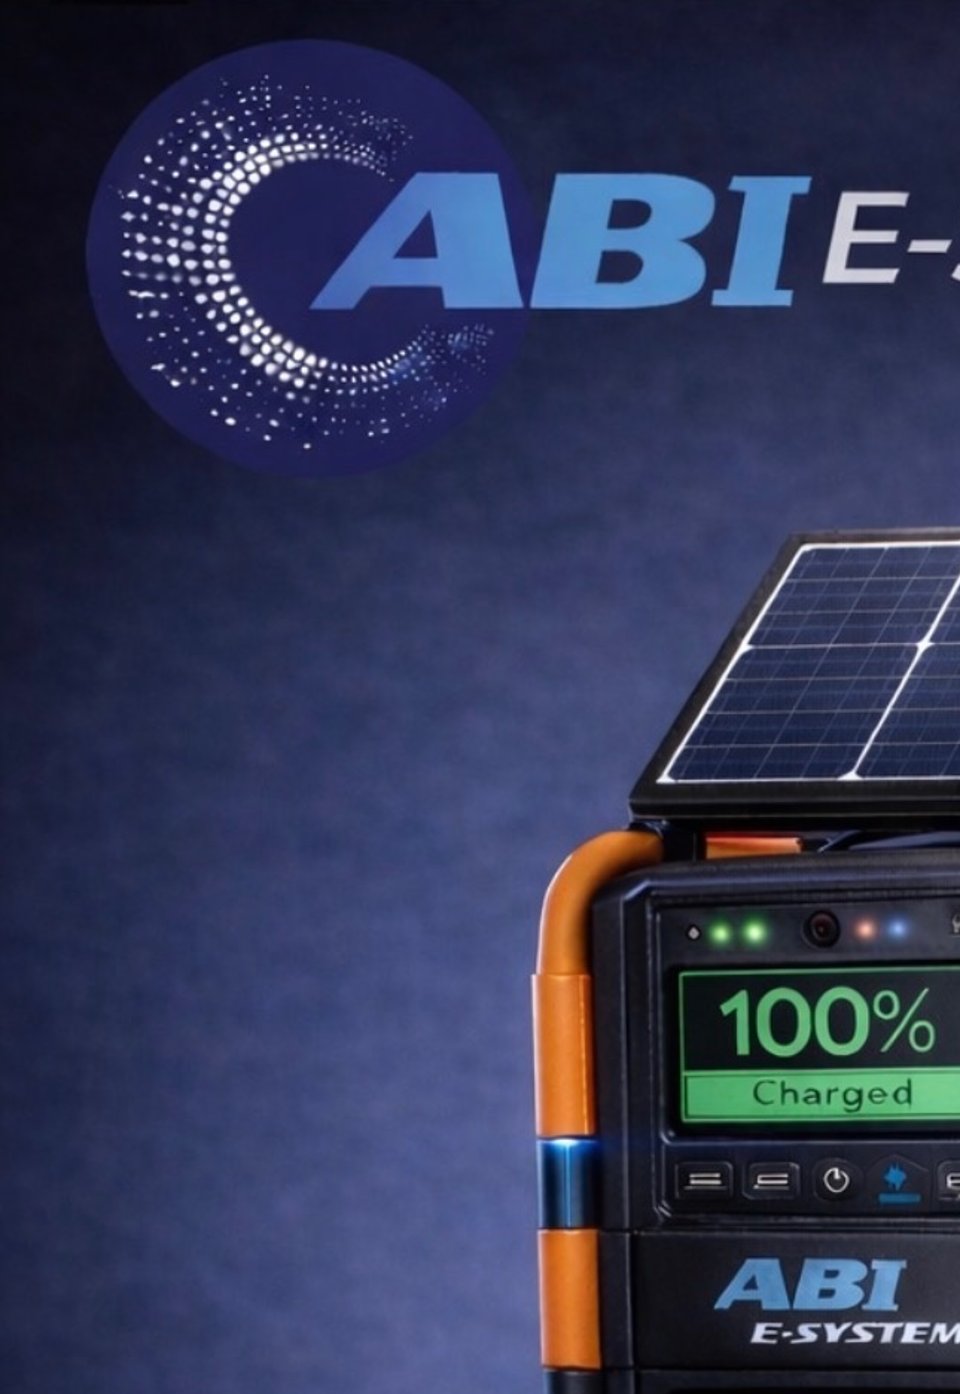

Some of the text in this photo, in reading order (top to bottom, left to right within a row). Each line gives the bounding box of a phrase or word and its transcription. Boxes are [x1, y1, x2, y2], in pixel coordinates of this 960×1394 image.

[720, 986, 936, 1057] 100%
[752, 1078, 913, 1113] Charged
[714, 1258, 906, 1311] ABI
